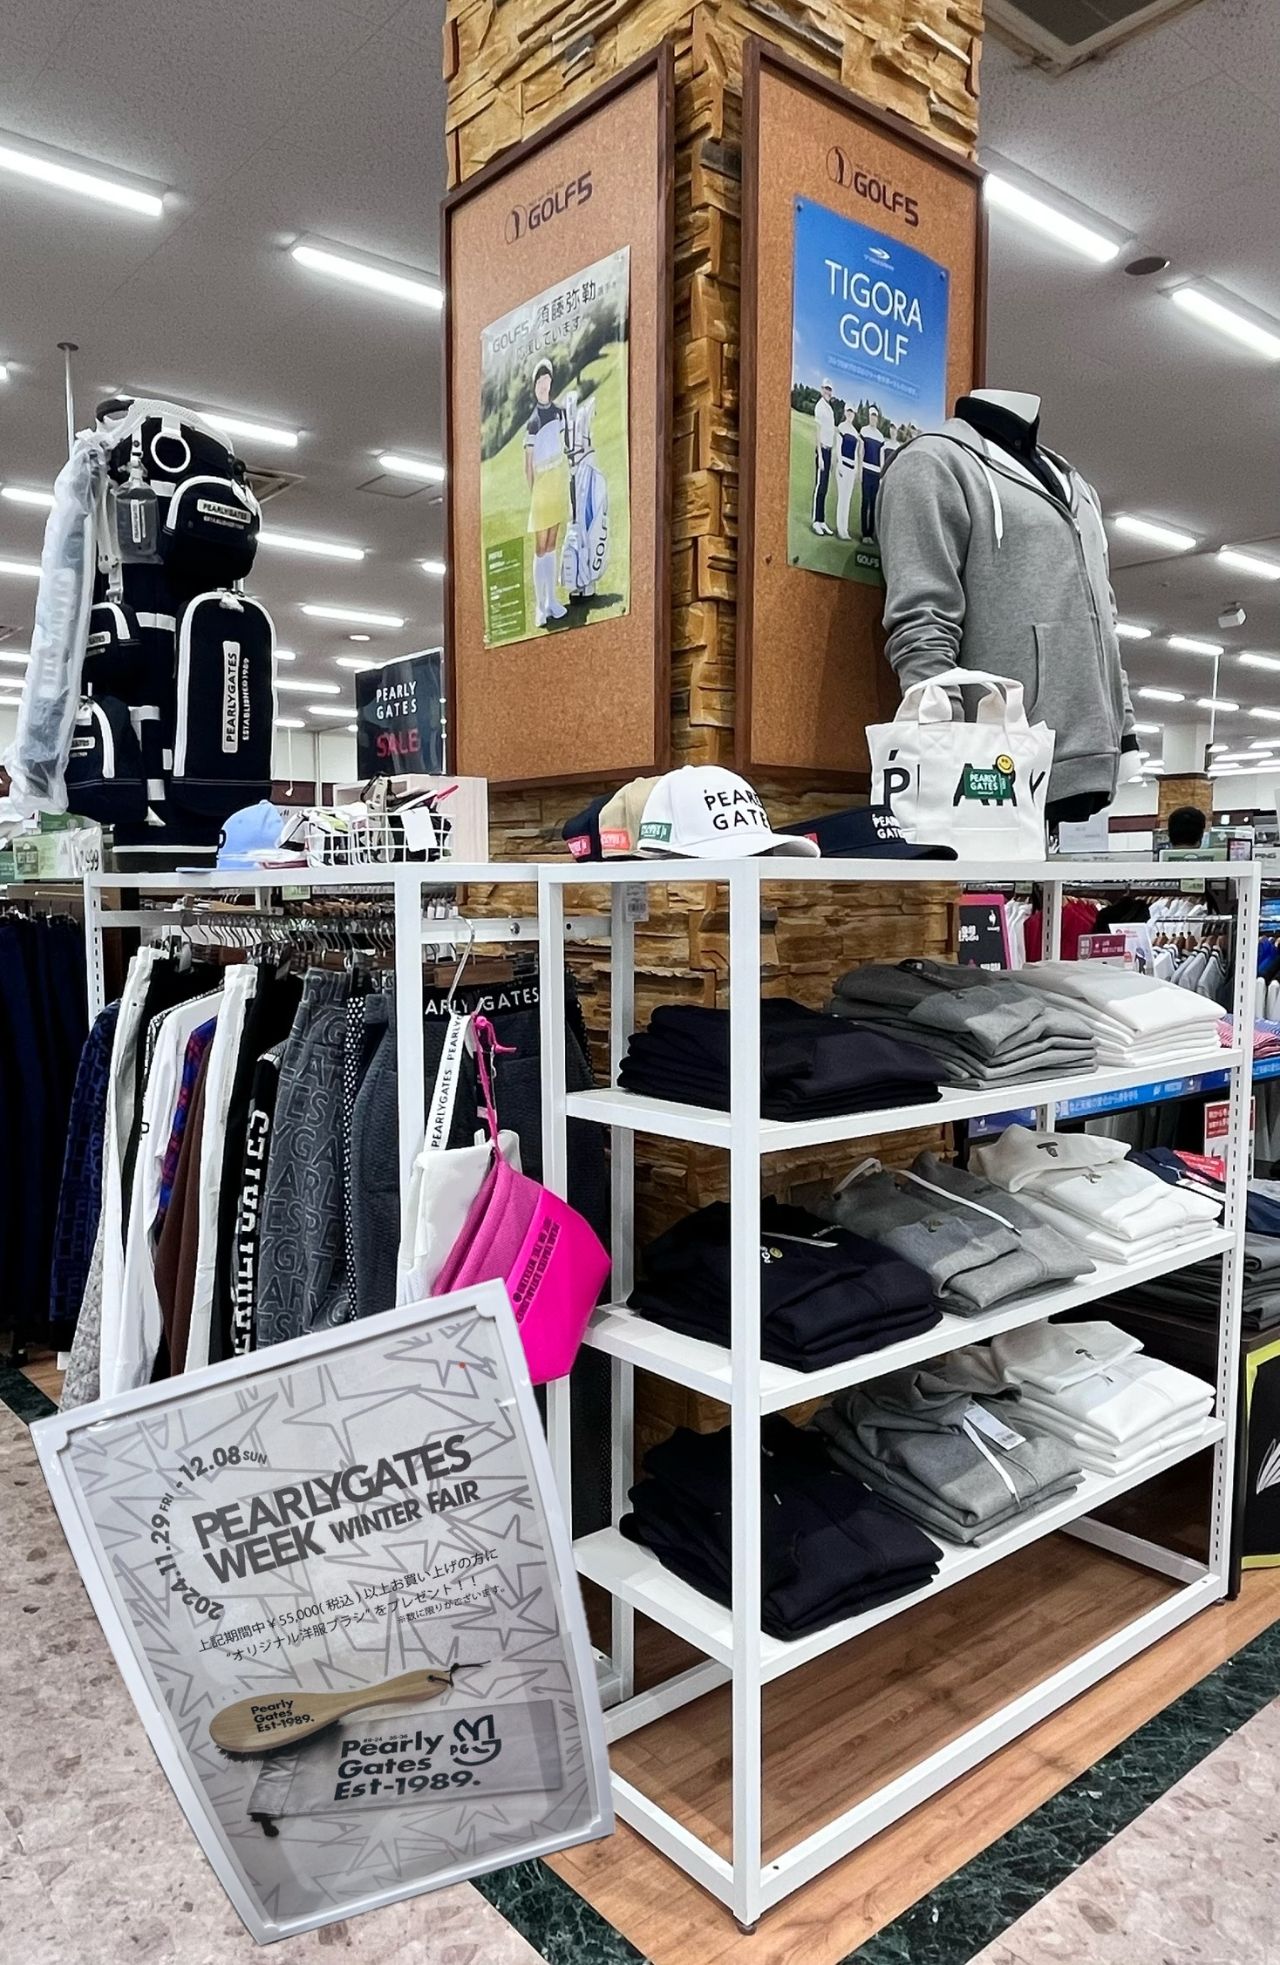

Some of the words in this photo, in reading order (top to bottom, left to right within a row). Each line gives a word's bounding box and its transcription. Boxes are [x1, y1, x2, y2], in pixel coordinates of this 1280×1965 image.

[528, 170, 593, 230] GOLF5
[853, 171, 919, 227] GOLF5
[824, 258, 923, 333] TIGORA
[492, 319, 530, 353] GOLF5
[839, 313, 910, 366] GOLF
[226, 652, 237, 743] PEARLYGATES
[376, 681, 417, 703] PEARLY
[376, 698, 417, 720] GATES
[376, 728, 421, 758] SALE
[970, 782, 999, 791] GATES
[482, 986, 540, 1012] GATES
[431, 1069, 453, 1148] PEARLYGATES
[242, 1450, 268, 1465] SUN
[159, 1492, 175, 1512] FRI
[192, 1434, 472, 1550] PEARLYGATES
[203, 1520, 326, 1584] WEEK
[328, 1498, 423, 1544] WINTER
[426, 1479, 481, 1514] FAIR
[150, 1513, 224, 1621] 2024.11.29
[251, 1699, 294, 1715] Pearly
[254, 1709, 293, 1723] Gates
[256, 1714, 315, 1733] Est-1989.
[341, 1730, 444, 1759] Pearly
[338, 1756, 433, 1780] Gates
[333, 1770, 482, 1801] Est-1989.
